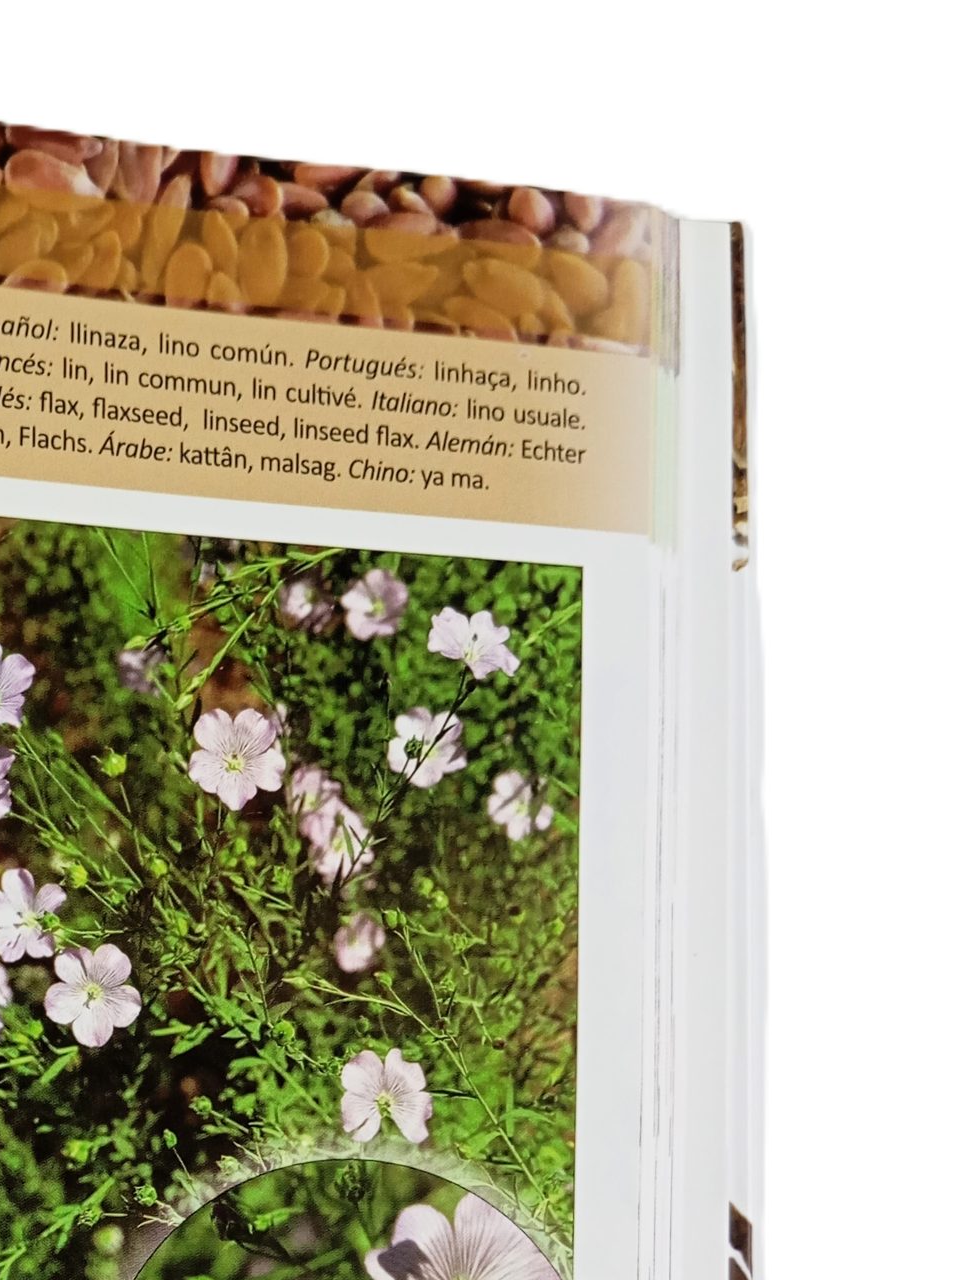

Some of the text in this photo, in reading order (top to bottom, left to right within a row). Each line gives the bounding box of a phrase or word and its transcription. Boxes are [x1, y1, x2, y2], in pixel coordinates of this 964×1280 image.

[63, 356, 94, 386] lin,
[104, 360, 129, 386] lin
[138, 371, 243, 403] commun,
[252, 376, 276, 401] lin
[286, 383, 362, 409] cultivé.
[371, 390, 459, 418] Italiano:
[467, 397, 506, 422] lino
[514, 408, 585, 430] usuale.
[70, 321, 147, 356] llinaza,
[159, 331, 200, 358] lino
[210, 342, 294, 368] común.
[305, 348, 424, 380] Portugués:
[435, 360, 517, 392] linhaça,
[528, 369, 586, 396] linho.
[19, 424, 92, 454] Flachs.
[98, 430, 173, 462] Árabe:
[180, 441, 253, 474] kattân,
[261, 452, 341, 482] malsag.
[348, 457, 416, 484] Chino:
[420, 469, 444, 490] ya
[451, 472, 489, 490] ma.
[39, 390, 84, 421] flax,
[92, 396, 189, 432] flaxseed,
[204, 408, 286, 442] linseed,
[294, 417, 369, 445] linseed
[375, 424, 420, 449] flax.
[425, 430, 514, 458] Alemán:
[522, 439, 587, 464] Echter
